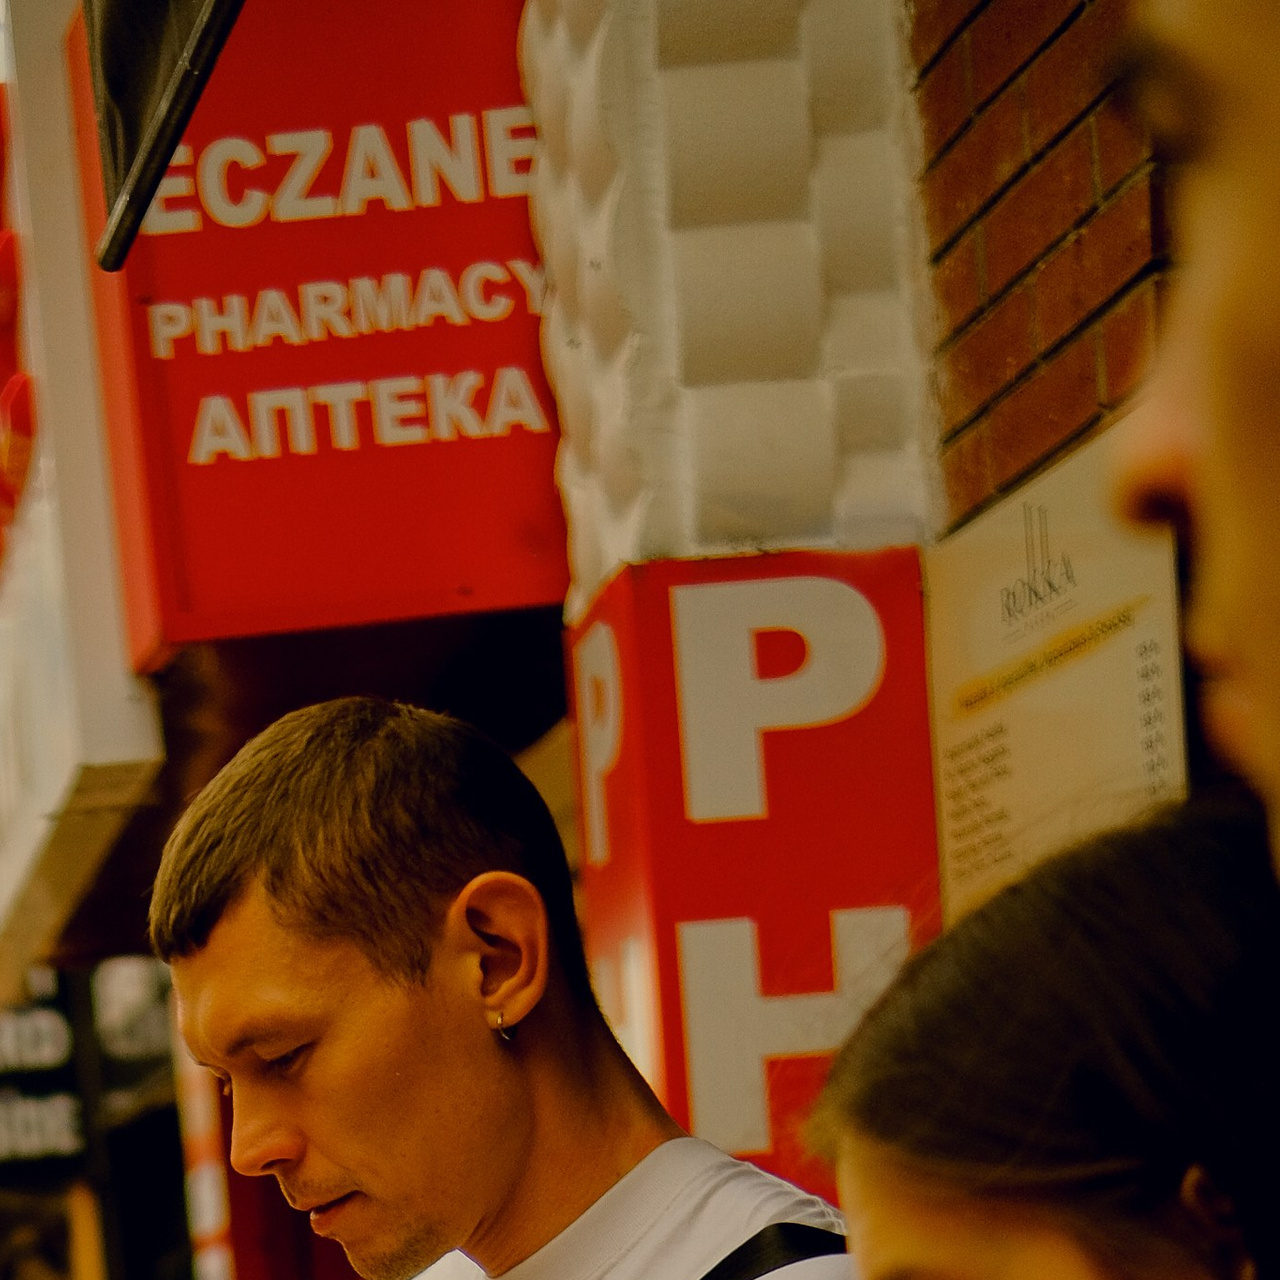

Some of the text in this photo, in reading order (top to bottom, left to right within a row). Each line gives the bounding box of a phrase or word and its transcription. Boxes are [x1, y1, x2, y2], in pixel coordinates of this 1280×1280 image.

[138, 106, 538, 235] ECZANE
[149, 260, 549, 360] PHARMACY
[188, 367, 550, 465] АПТЕКА
